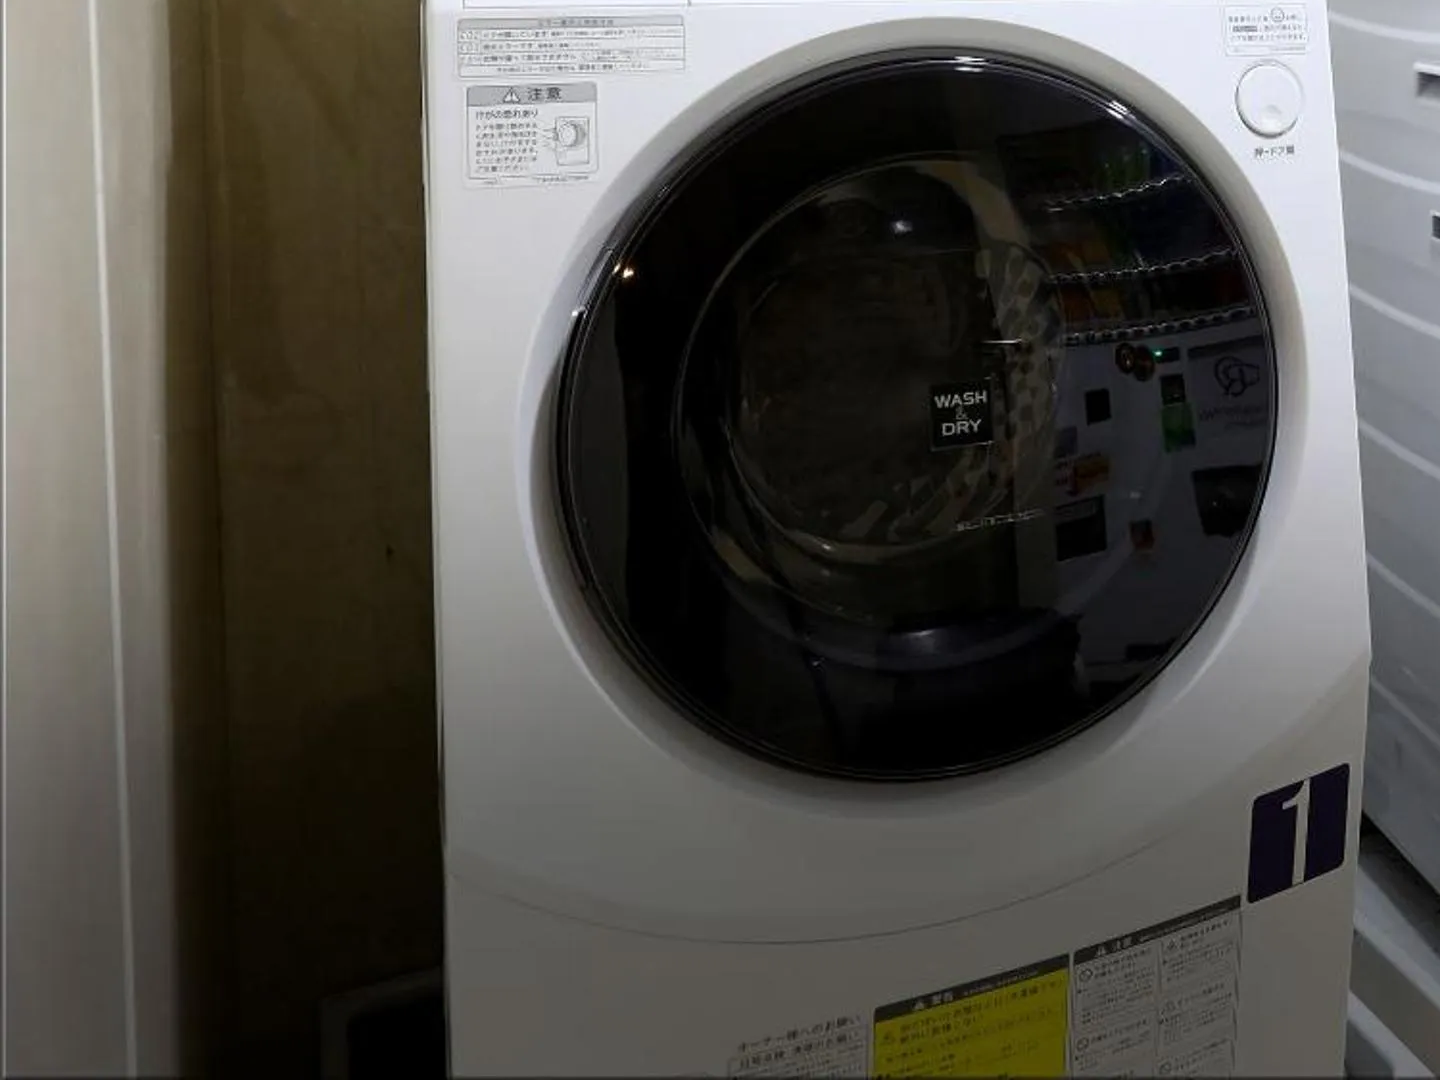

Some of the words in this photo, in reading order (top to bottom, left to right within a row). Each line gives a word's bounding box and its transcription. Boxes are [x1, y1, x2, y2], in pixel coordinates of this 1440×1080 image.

[934, 390, 988, 409] WASH
[942, 419, 982, 436] DRY
[1282, 777, 1311, 884] 1
